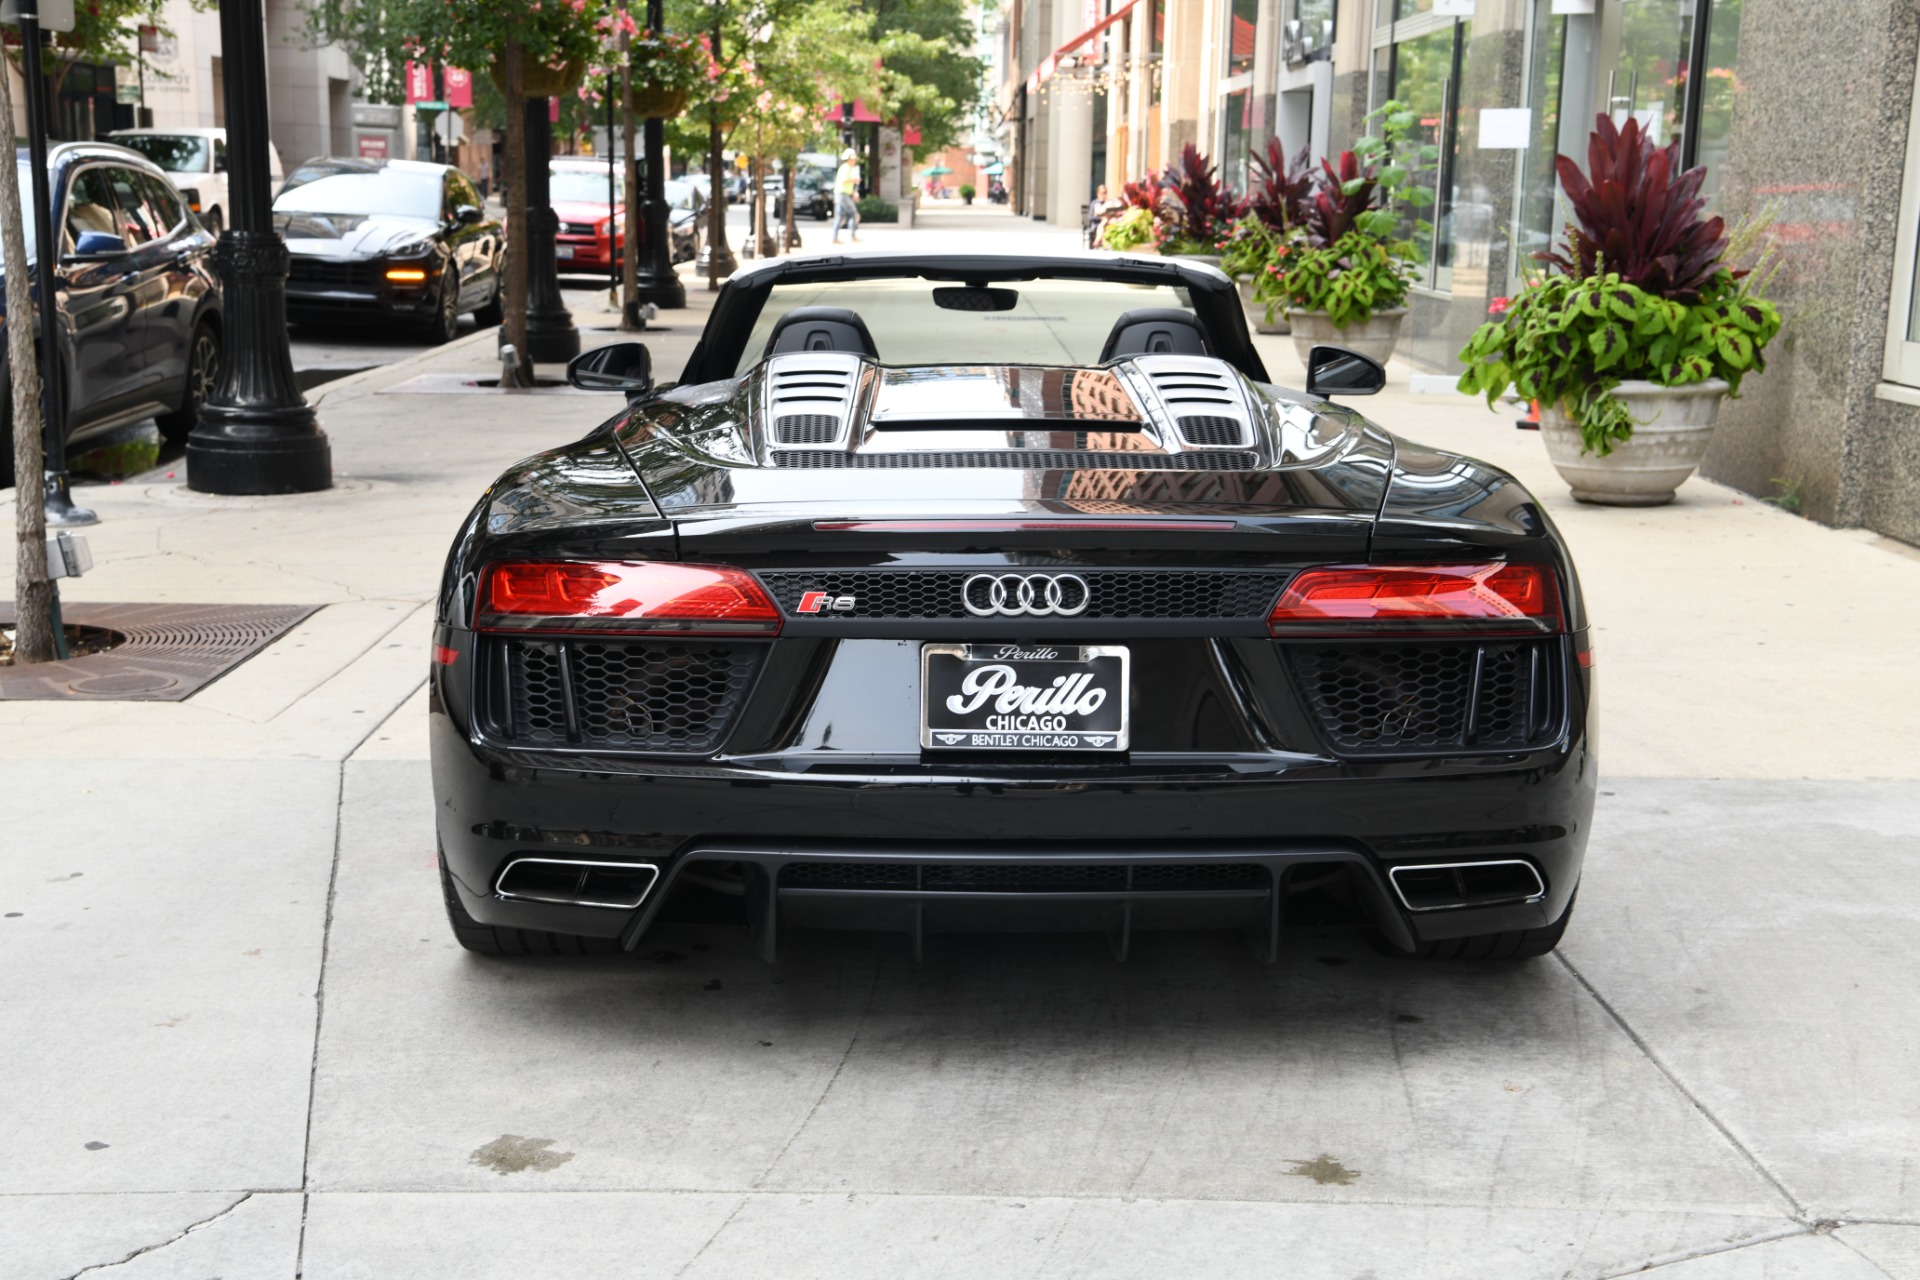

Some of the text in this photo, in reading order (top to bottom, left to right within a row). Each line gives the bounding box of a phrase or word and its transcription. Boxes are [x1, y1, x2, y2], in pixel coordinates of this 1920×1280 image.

[810, 595, 857, 611] R8
[993, 645, 1059, 660] Perillo
[946, 664, 1107, 716] Perillo
[985, 715, 1067, 731] CHICAGO
[971, 734, 1079, 748] BENTLEY CHICAGO
